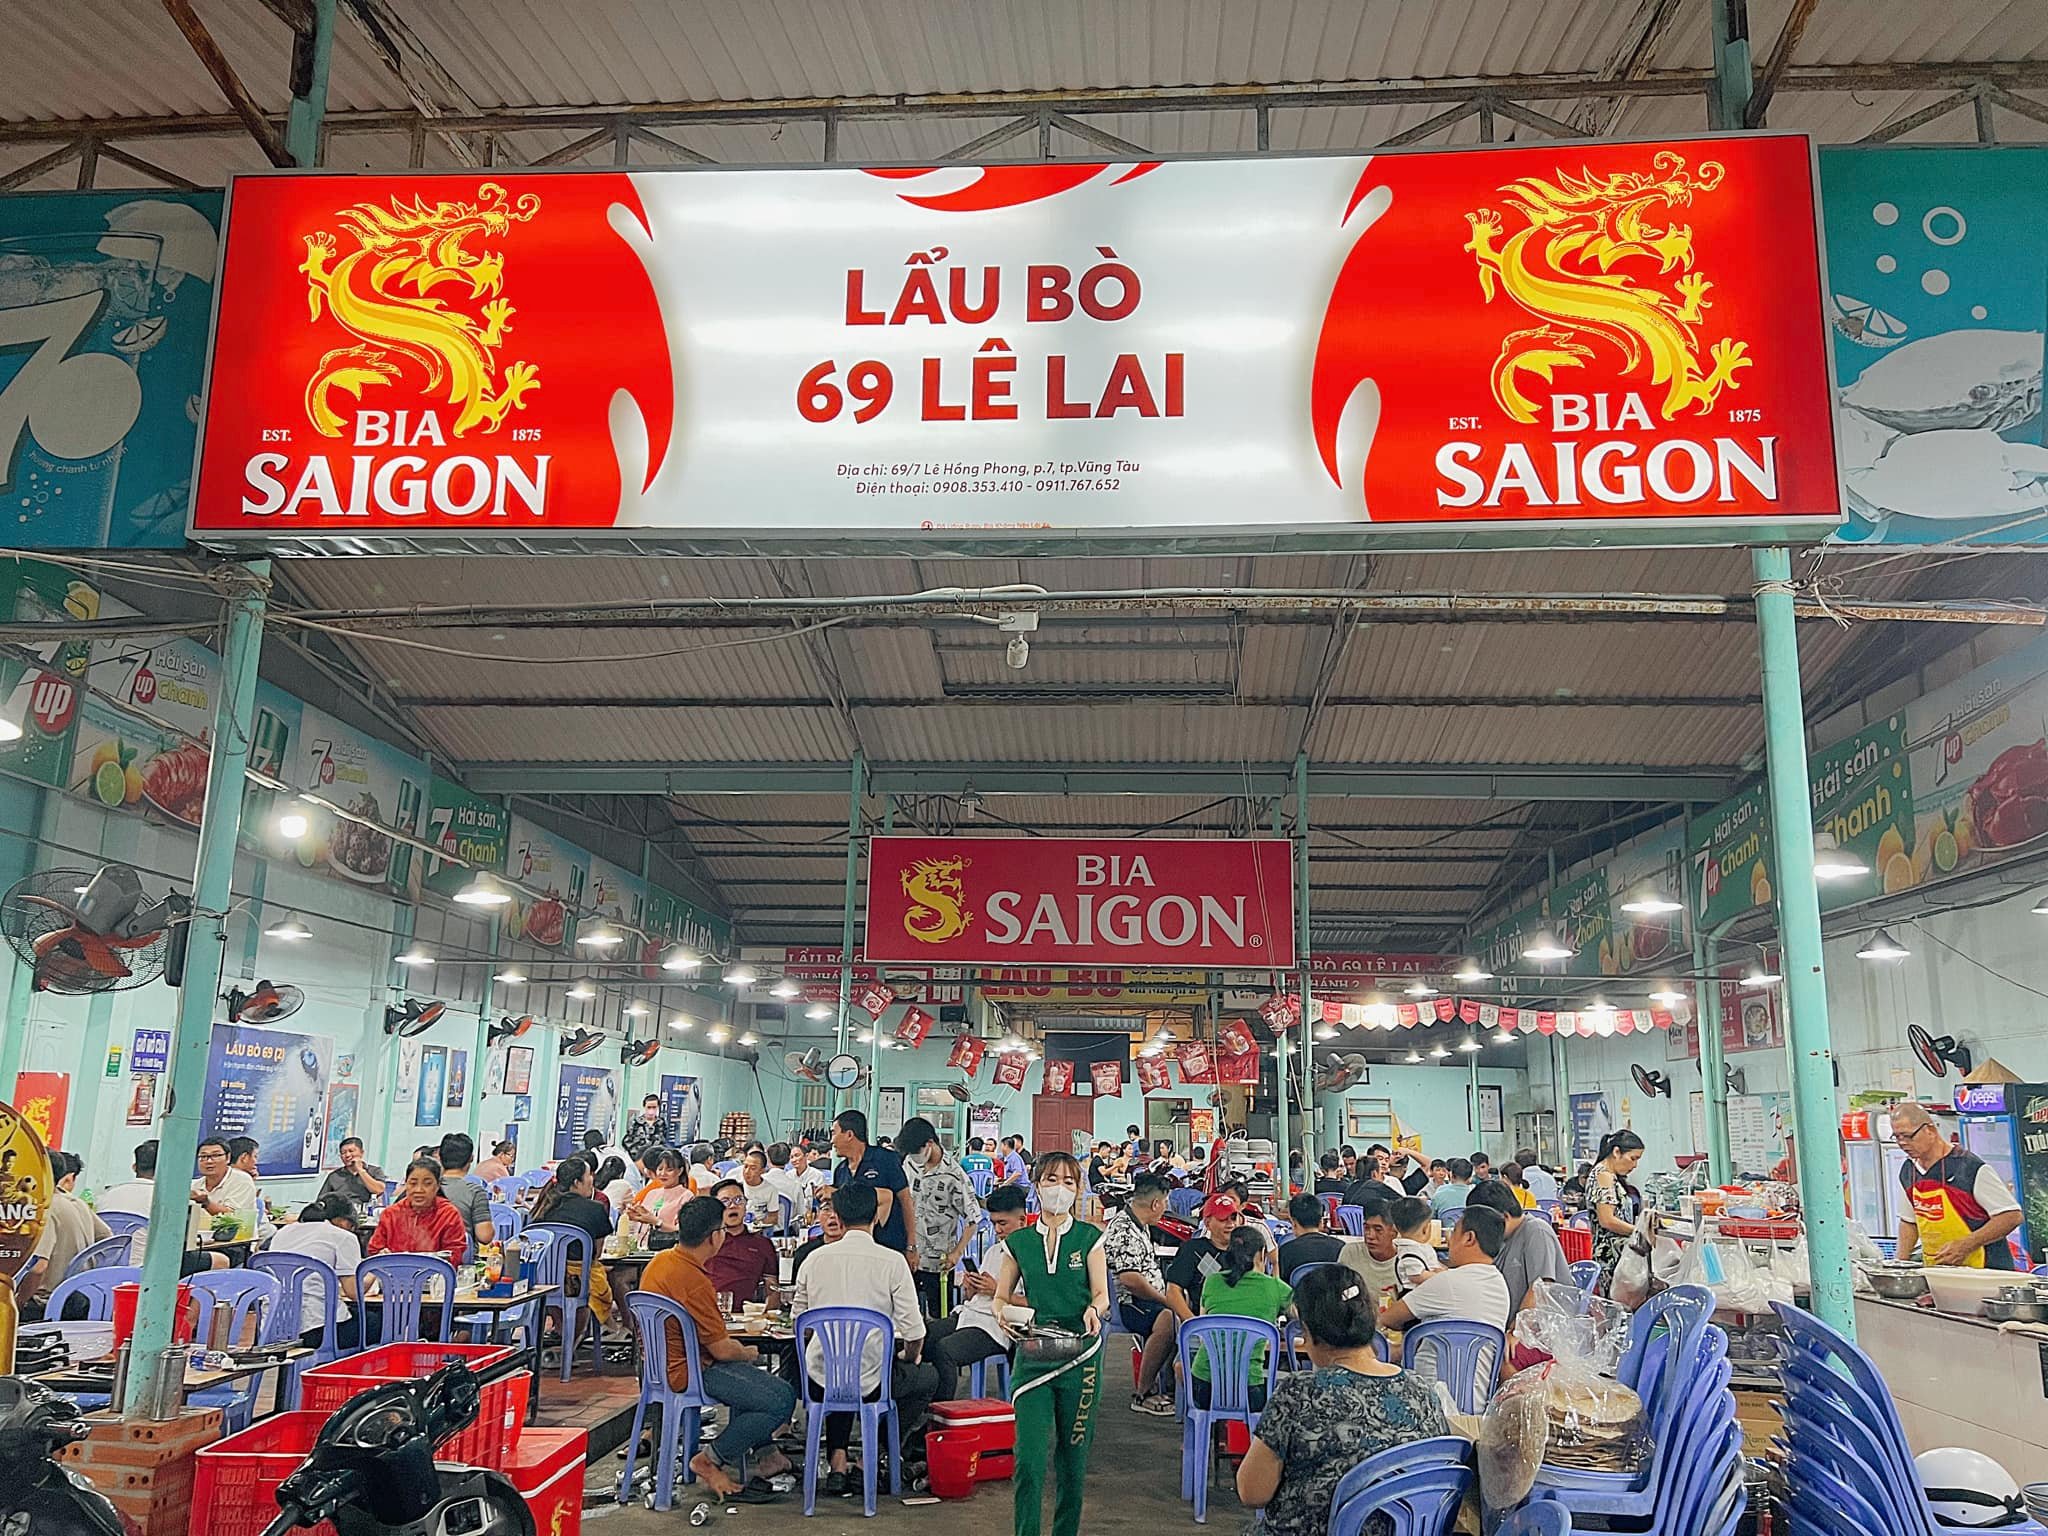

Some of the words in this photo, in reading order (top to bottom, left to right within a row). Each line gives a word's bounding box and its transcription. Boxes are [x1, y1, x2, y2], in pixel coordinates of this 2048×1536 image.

[846, 246, 1000, 326] LẨU
[1026, 246, 1142, 323] BÒ
[796, 359, 894, 425] 69
[921, 337, 1019, 421] LÊ
[1047, 353, 1184, 419] LAI
[353, 409, 447, 447] BIA
[1448, 416, 1482, 430] EST.
[1550, 392, 1656, 432] BIA
[1728, 408, 1761, 423] 1875
[262, 429, 292, 442] EST.
[511, 428, 542, 442] 1875
[241, 452, 553, 517] SAIGON
[837, 464, 860, 479] Địa
[891, 463, 921, 477] 69/7
[924, 463, 940, 476] Lê
[983, 462, 1030, 477] Phong,
[1033, 462, 1055, 476] p.7,
[1060, 461, 1112, 476] tp.Vũng
[1116, 460, 1140, 472] Tàu
[856, 481, 886, 497] Điện
[889, 481, 929, 497] thoại:
[932, 480, 1023, 494] 0908.353.410
[1035, 478, 1121, 493] 0911.767.652
[1434, 435, 1778, 507] SAIGON
[1811, 760, 1841, 809] Hải
[1843, 738, 1879, 785] sản
[457, 801, 477, 827] Hải
[477, 804, 497, 829] sản
[1714, 812, 1732, 844] Hải
[1732, 798, 1752, 830] sản
[1076, 855, 1157, 887] BIA
[984, 891, 1247, 949] SAIGON
[1069, 1360, 1098, 1447] SPECIAL
